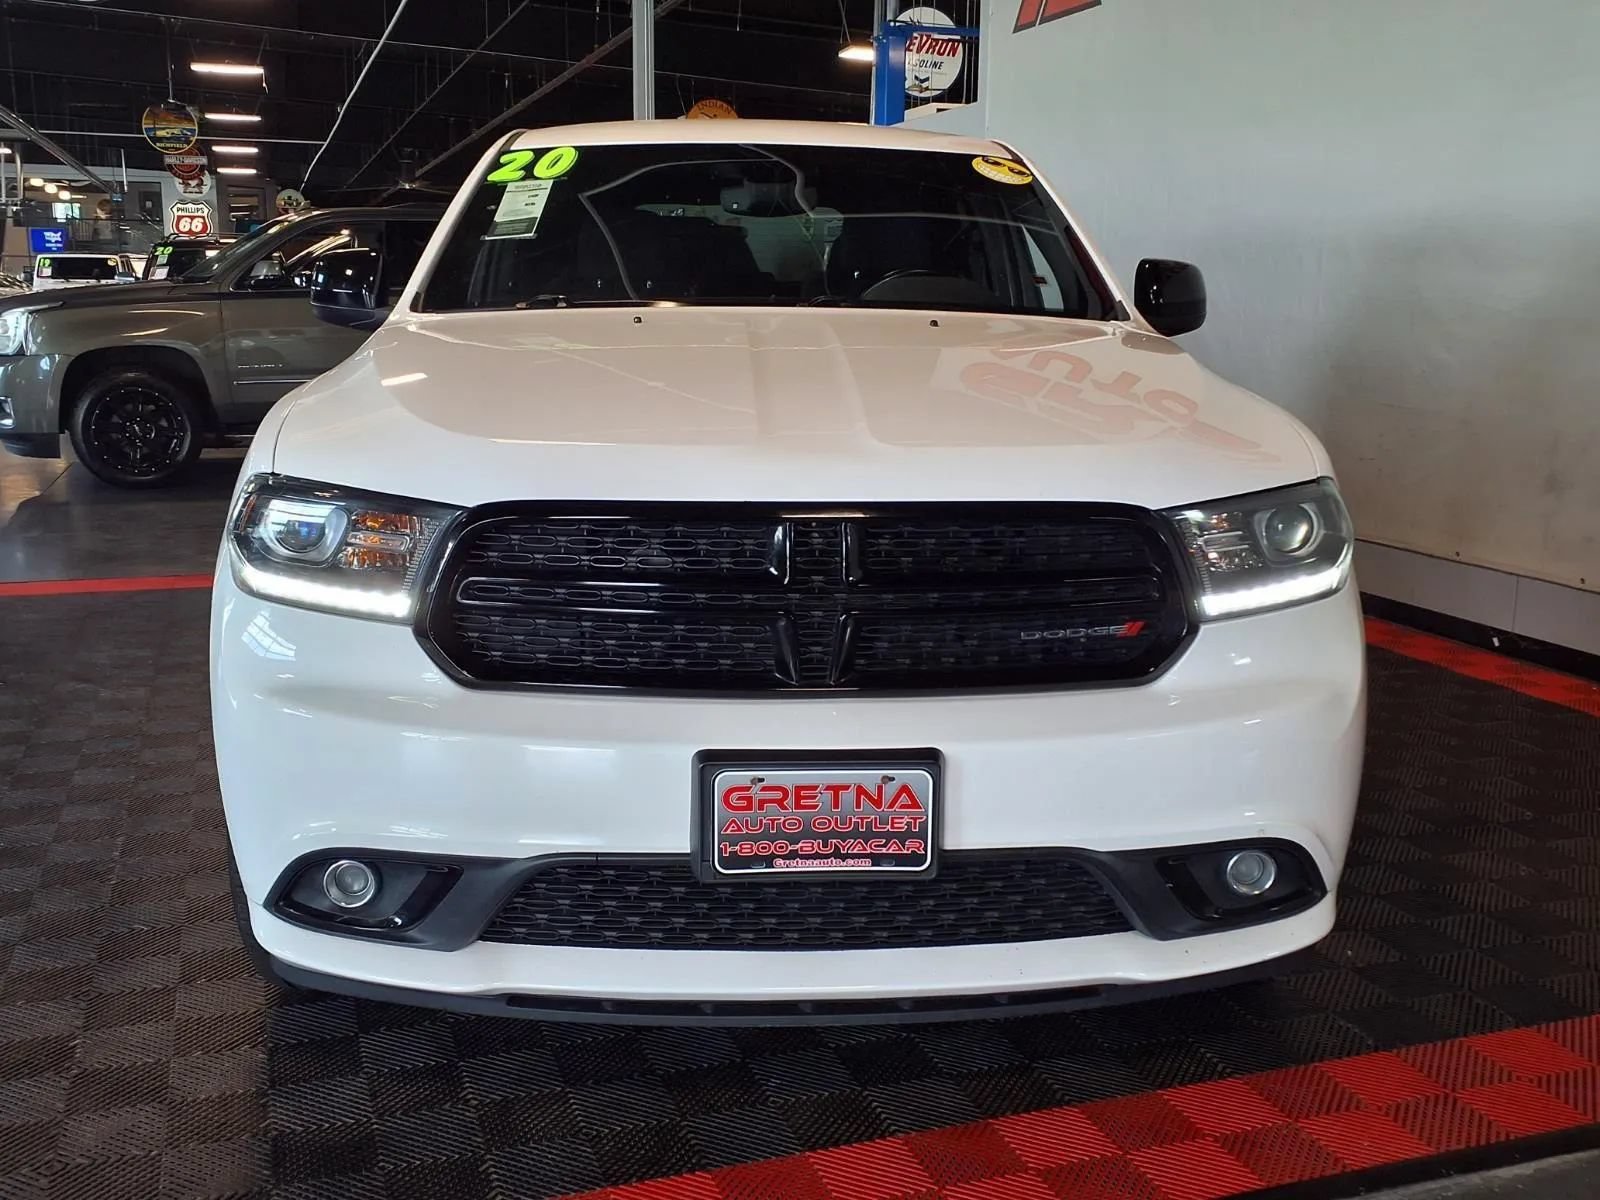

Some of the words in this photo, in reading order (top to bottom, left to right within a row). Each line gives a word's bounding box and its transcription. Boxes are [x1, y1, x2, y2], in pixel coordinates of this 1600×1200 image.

[905, 32, 961, 57] EVRON
[486, 147, 578, 183] 20
[176, 206, 205, 214] PHILLIPS
[178, 217, 204, 232] 66
[154, 246, 173, 256] 20
[40, 258, 51, 268] 19
[1020, 625, 1128, 640] DODGE
[721, 783, 925, 813] GRETNA
[721, 816, 804, 834] AUTO
[811, 815, 927, 832] OUTLET
[720, 838, 925, 857] 1-800-BUYACAR
[773, 858, 872, 868] Gretnaauto.com
